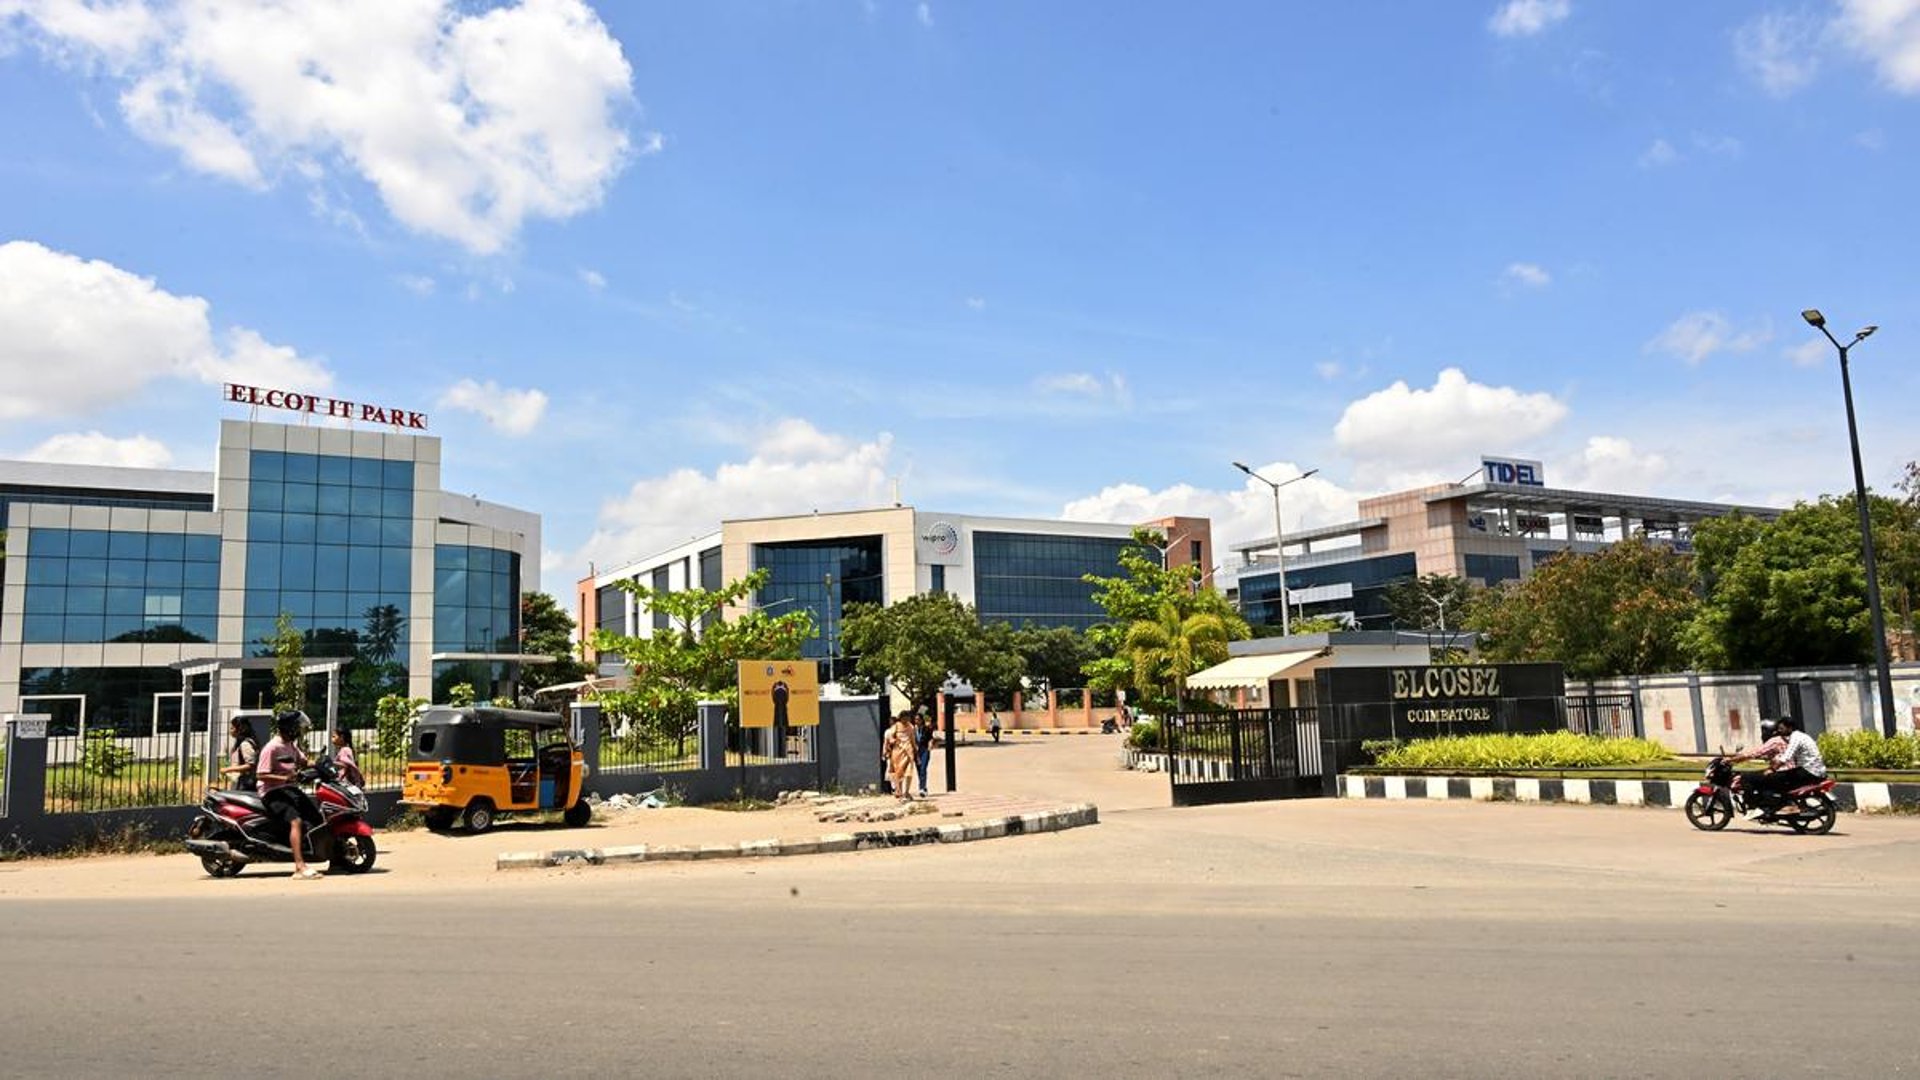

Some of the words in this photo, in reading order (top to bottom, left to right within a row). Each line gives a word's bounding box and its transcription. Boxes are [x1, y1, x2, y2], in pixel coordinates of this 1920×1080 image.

[230, 383, 320, 413] ELCOT
[328, 399, 354, 418] IT
[361, 404, 426, 429] PARK
[1483, 460, 1544, 487] TIDEL
[1392, 667, 1500, 699] ELCOSEZ
[1407, 707, 1491, 723] COIMBATORE
